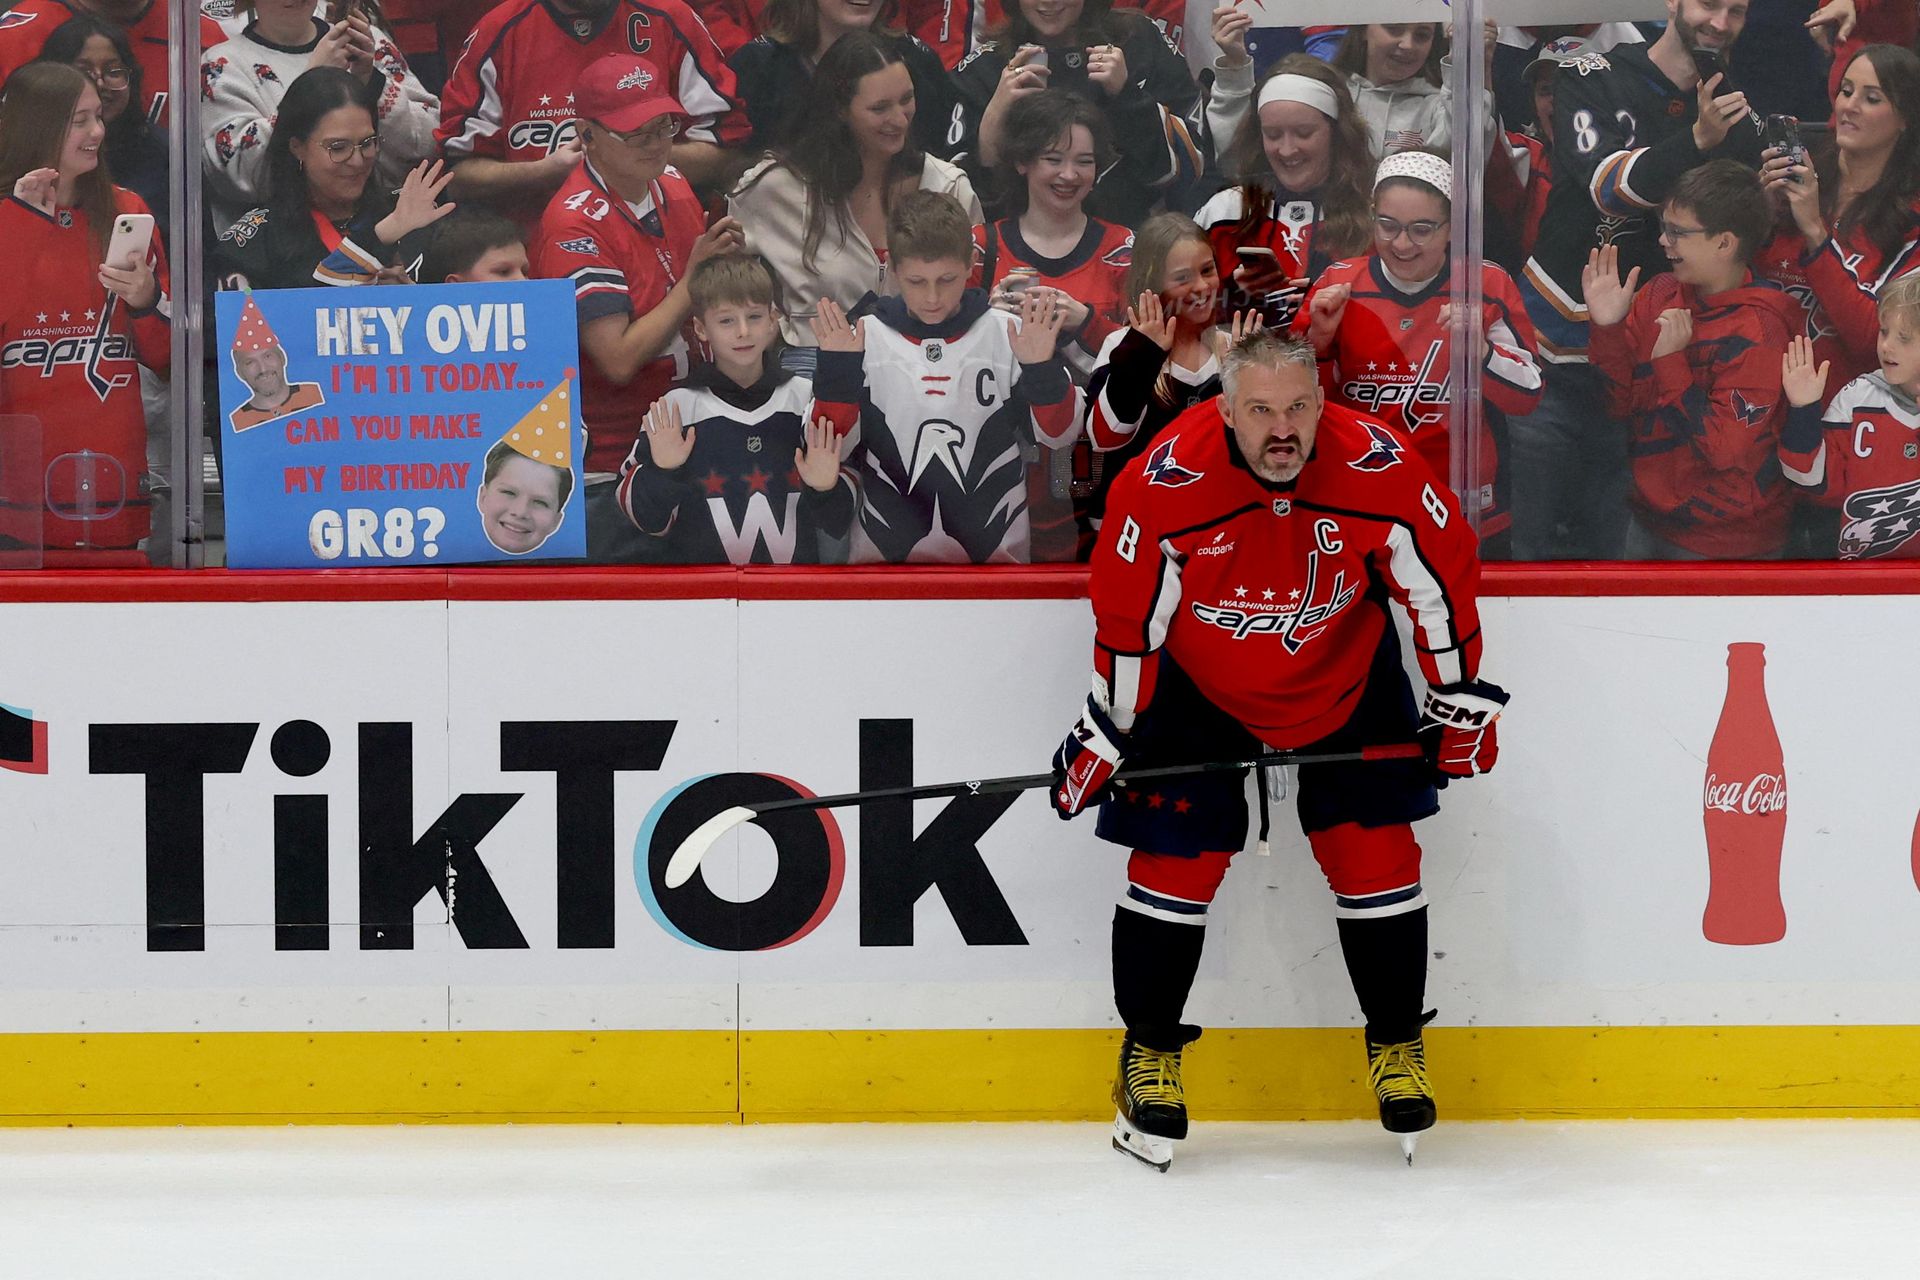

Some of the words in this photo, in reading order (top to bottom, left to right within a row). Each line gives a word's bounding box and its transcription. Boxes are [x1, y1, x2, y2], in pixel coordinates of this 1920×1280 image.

[627, 12, 651, 53] C
[947, 102, 964, 145] 8
[564, 189, 610, 221] 43
[23, 325, 95, 337] WASHINGTON
[316, 306, 412, 356] HEY
[425, 303, 527, 354] OVI!
[331, 363, 377, 394] I'M
[386, 364, 411, 393] 11
[421, 362, 545, 393] TODAY...
[976, 367, 995, 407] C
[1357, 373, 1417, 382] WASHINGTON
[285, 416, 340, 445] CAN
[351, 415, 400, 441] YOU
[409, 413, 482, 439] MAKE
[1854, 421, 1875, 458] C
[284, 466, 325, 494] MY
[340, 462, 470, 492] BIRTHDAY
[1421, 482, 1449, 529] 8
[308, 506, 446, 560] GR8?
[706, 491, 801, 565] W
[1116, 514, 1140, 563] 8
[1314, 518, 1343, 555] C
[1219, 600, 1298, 611] WASHINGTON
[88, 718, 1030, 952] TikTok
